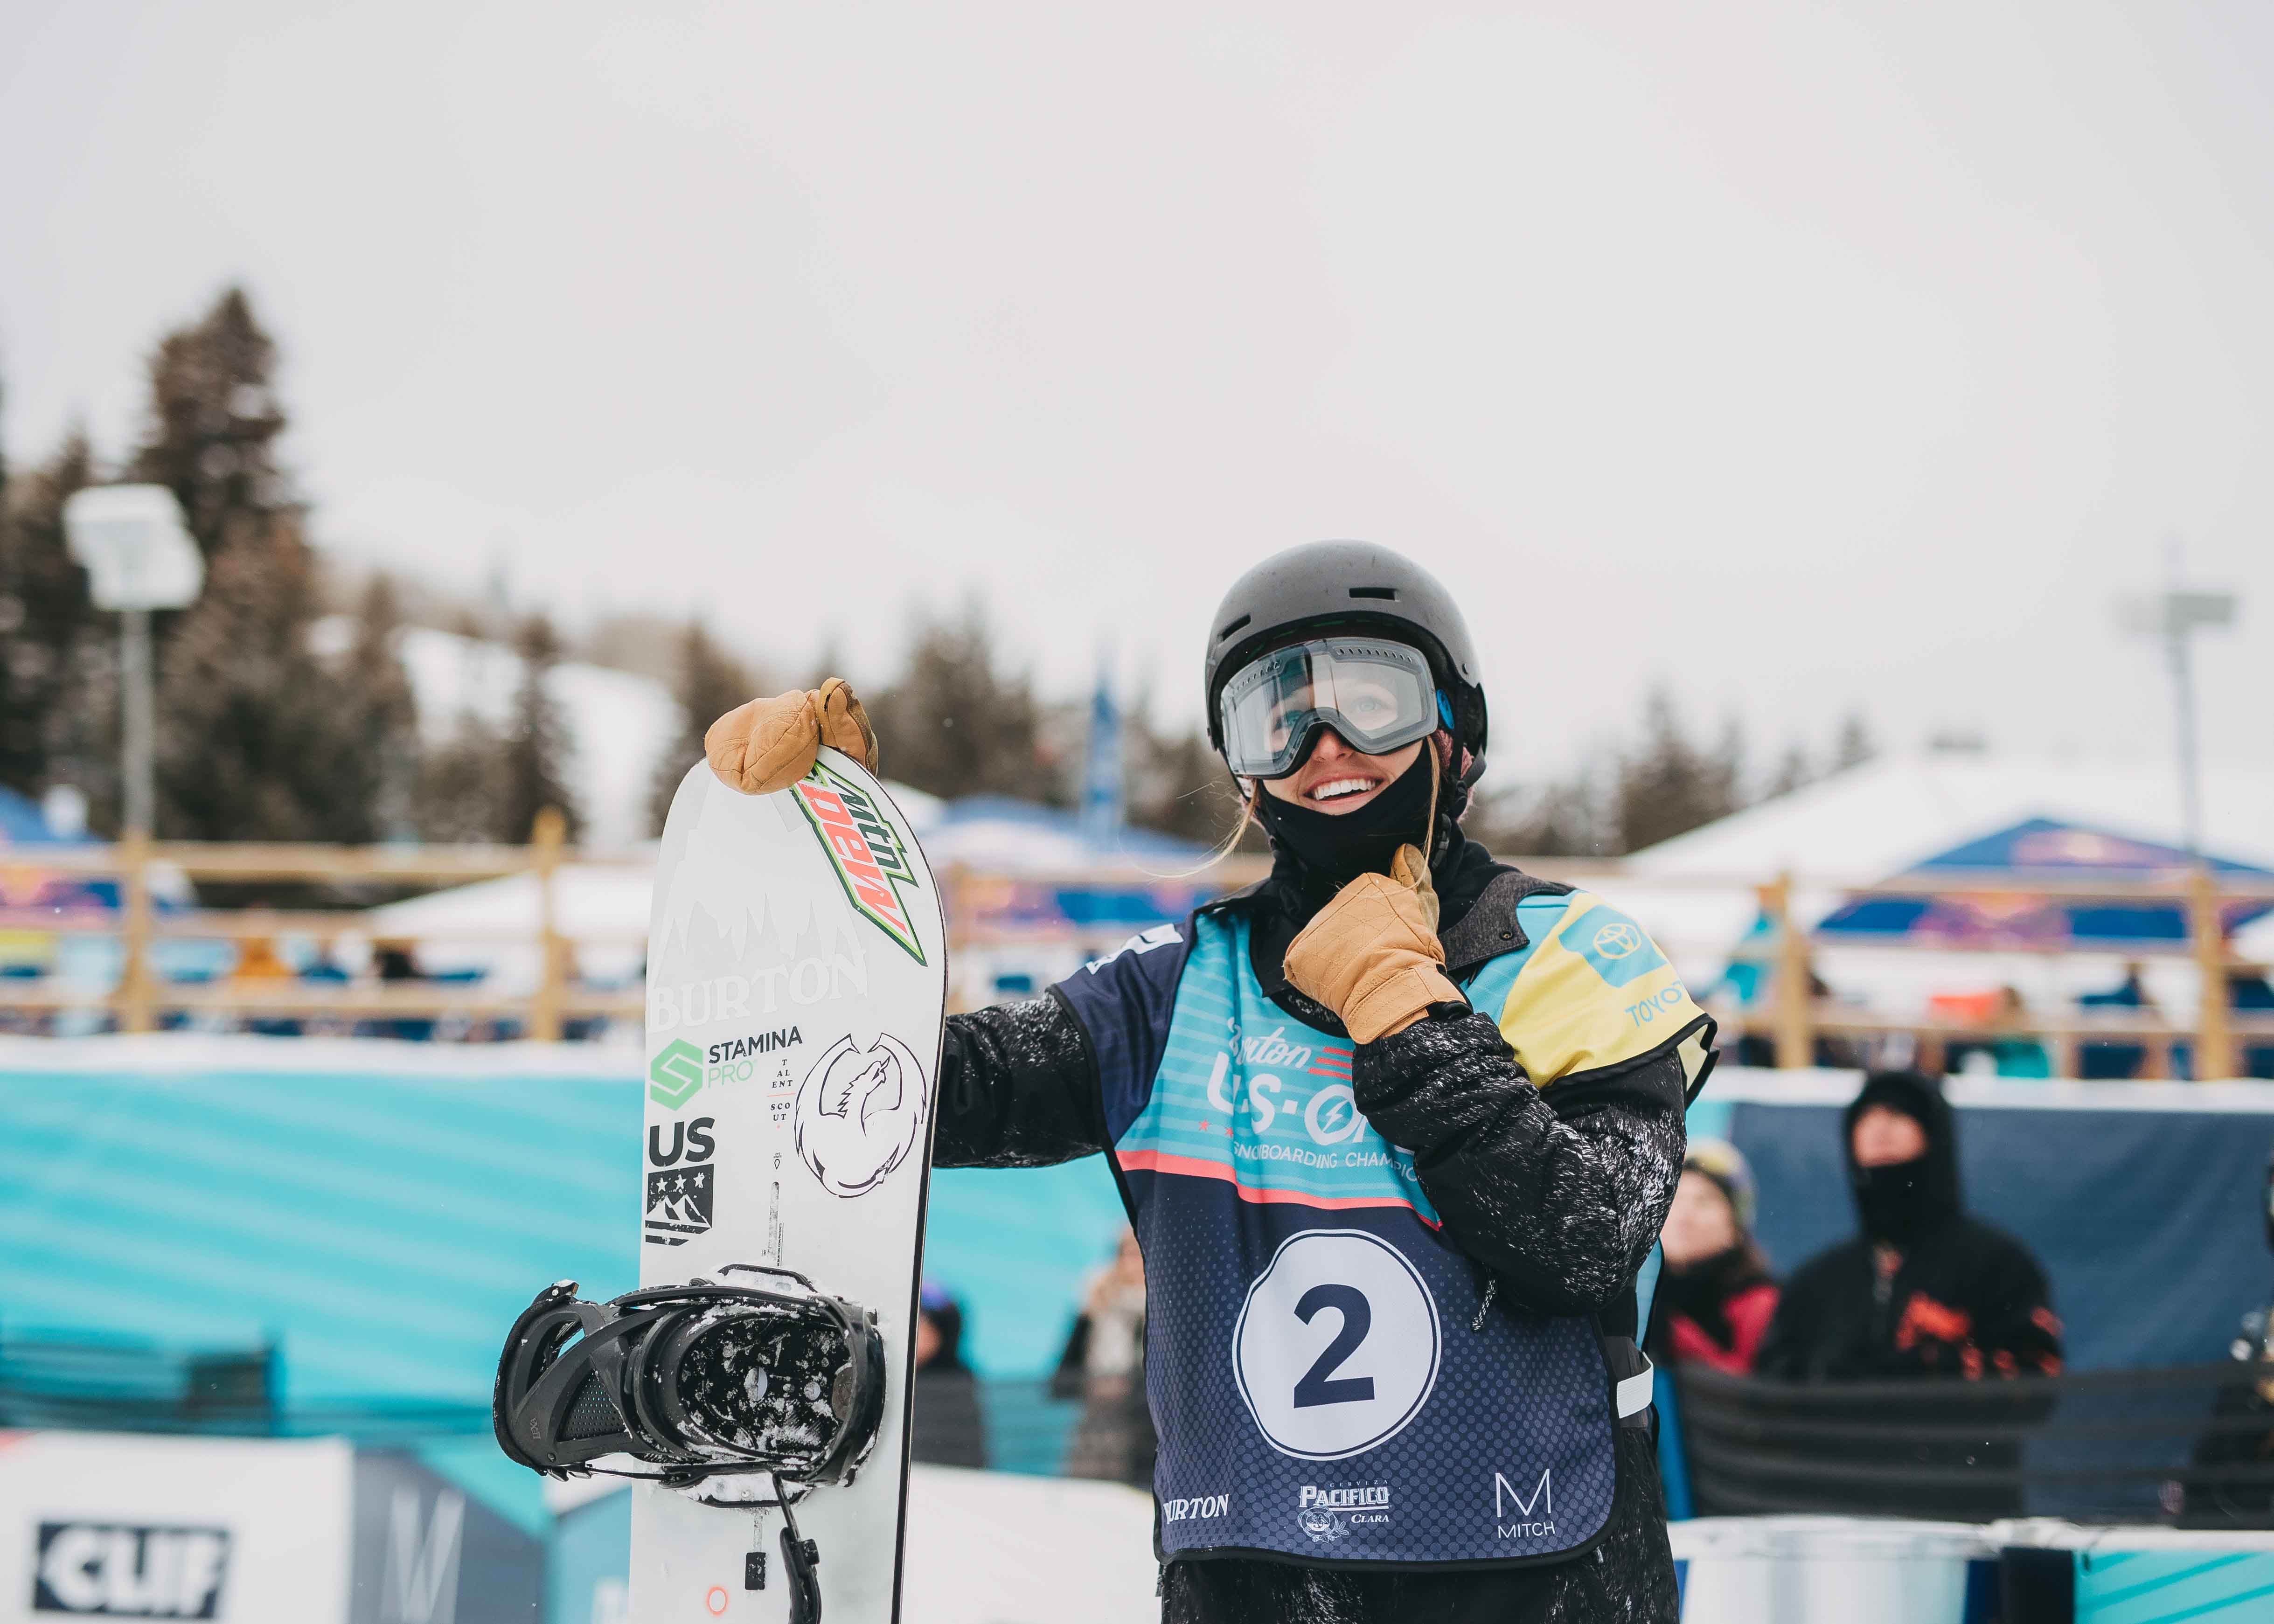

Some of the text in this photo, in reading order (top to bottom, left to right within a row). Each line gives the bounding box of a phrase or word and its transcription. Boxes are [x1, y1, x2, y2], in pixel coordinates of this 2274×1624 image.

[828, 776, 902, 870] Mtn
[646, 952, 869, 1034] BURTON
[709, 1026, 802, 1063] STAMINA
[709, 1060, 753, 1088] PRO
[772, 1080, 793, 1088] ENT
[770, 1102, 791, 1110] SCO
[649, 1117, 715, 1167] US
[1293, 1284, 1375, 1409] 2
[530, 1417, 541, 1440] LEXA
[1498, 1521, 1556, 1539] MITCH
[38, 1526, 230, 1615] CLIF
